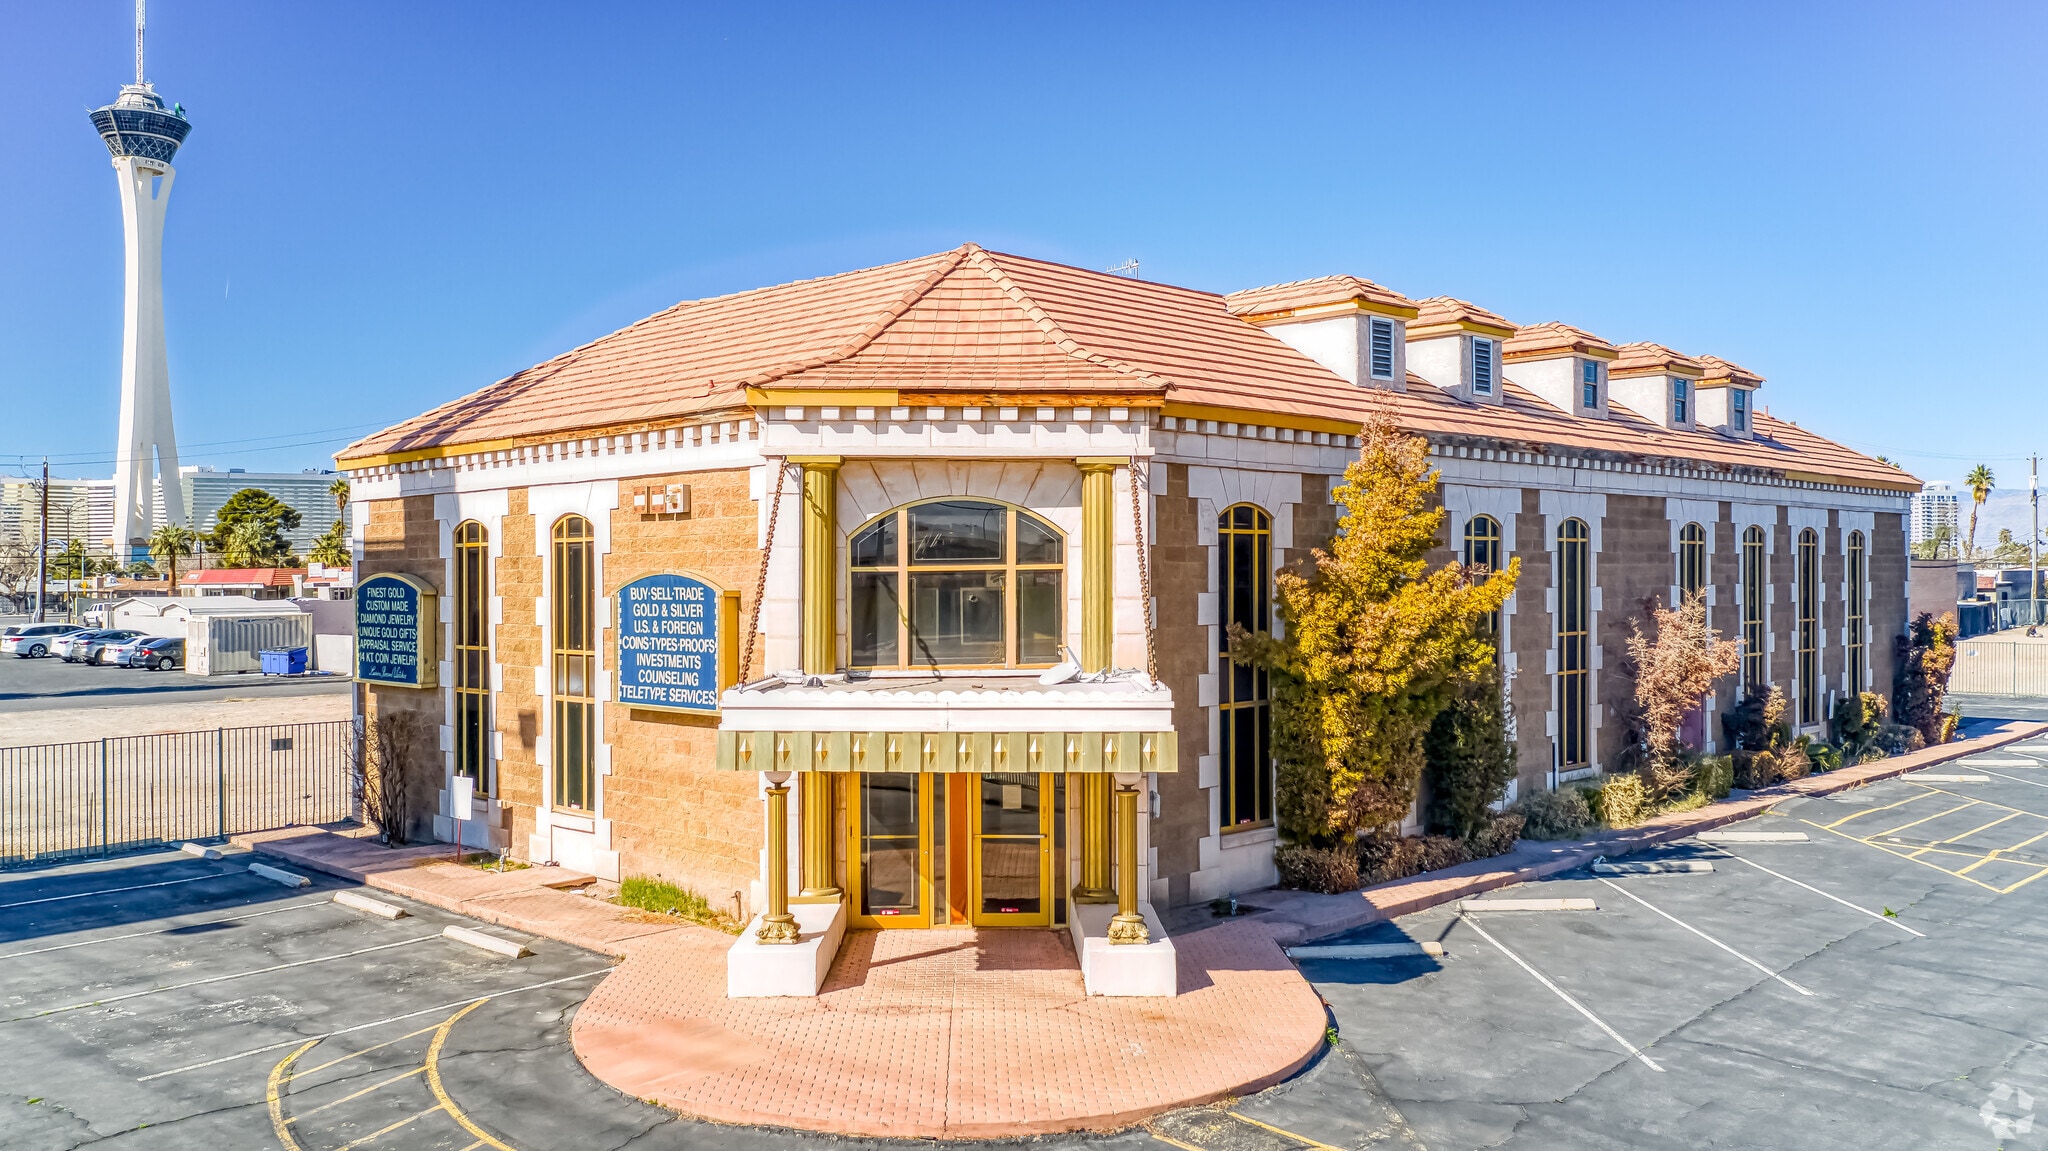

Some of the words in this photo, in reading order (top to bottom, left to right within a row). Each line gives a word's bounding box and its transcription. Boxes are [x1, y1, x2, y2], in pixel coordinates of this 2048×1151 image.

[367, 588, 386, 597] FINEST
[388, 588, 404, 598] GOLD
[366, 601, 390, 611] CUSTOM
[392, 601, 408, 611] MADE
[633, 604, 659, 617] GOLD
[662, 605, 668, 616] &
[670, 605, 703, 618] SILVER
[361, 614, 386, 624] DIAMOND
[388, 615, 414, 625] JEWELRY
[634, 620, 650, 633] U.S.
[652, 622, 659, 633] &
[662, 621, 703, 634] FOREIGN
[382, 628, 398, 638] GOLD
[399, 629, 416, 639] GIFTS
[360, 640, 389, 650] APPRAISAL
[391, 642, 416, 652] SERVICE
[375, 654, 389, 663] COIN
[390, 656, 416, 665] JEWELRY
[637, 654, 701, 669] INVESTMENTS
[638, 670, 698, 686] COUNSELING
[622, 685, 666, 700] TELETYPE
[669, 690, 715, 705] SERVICES
